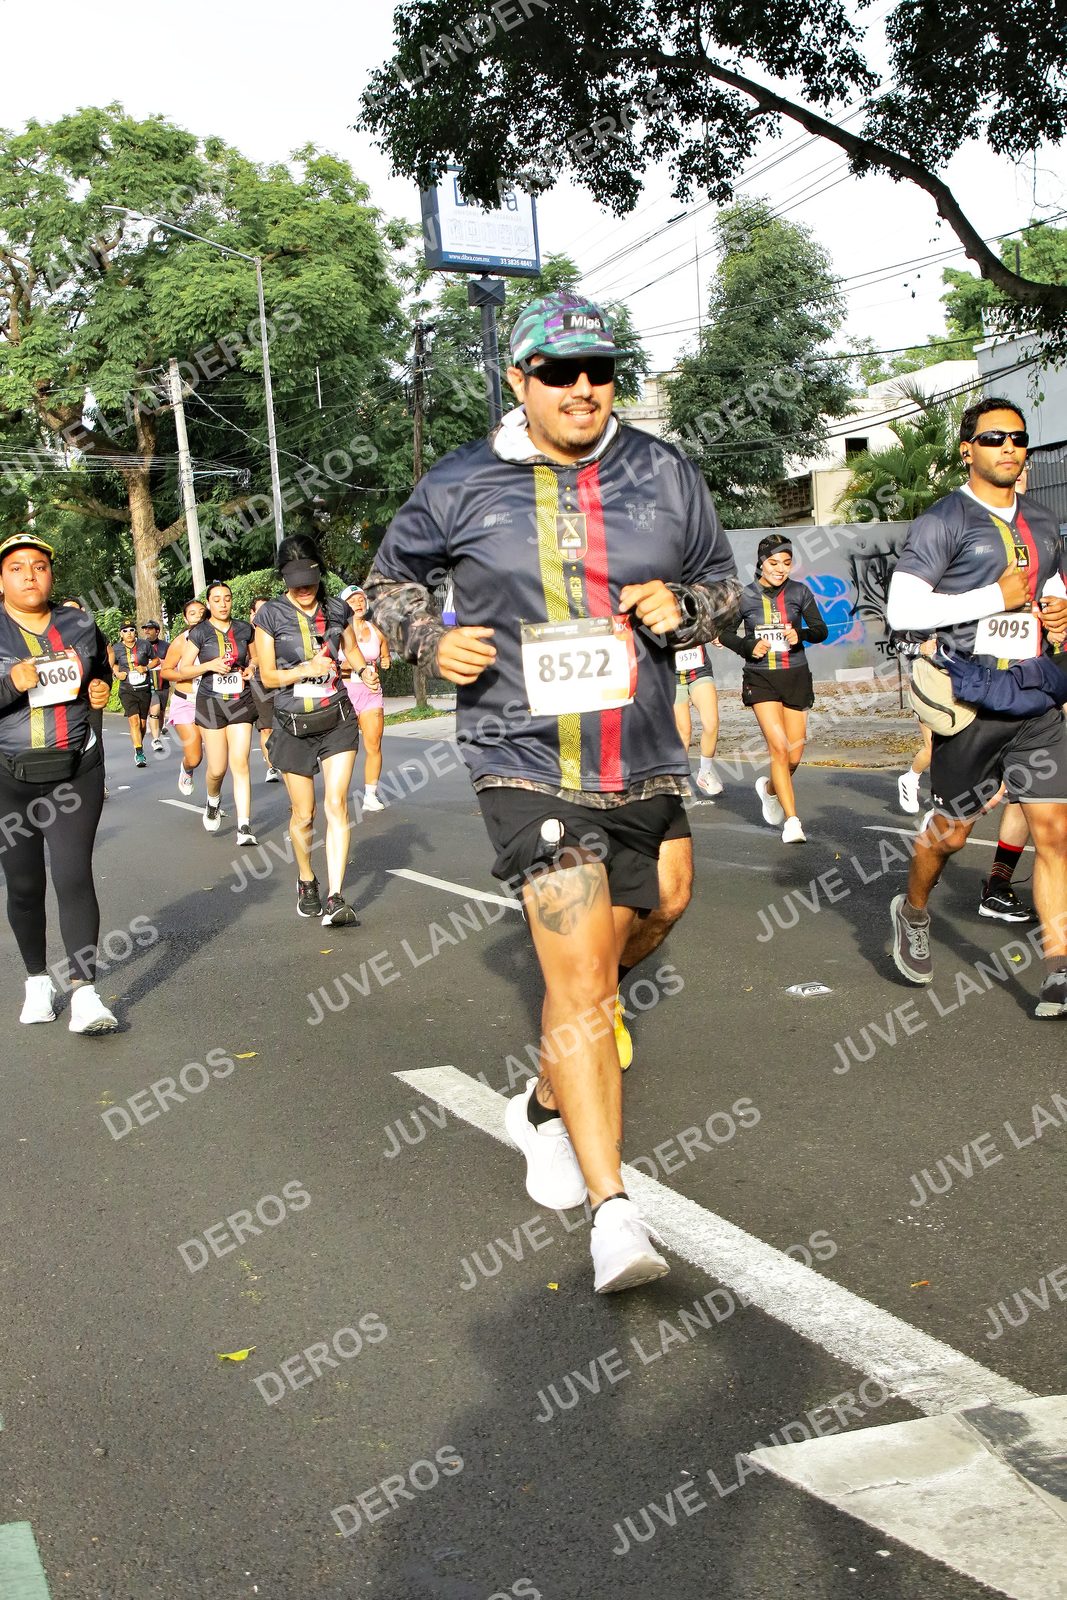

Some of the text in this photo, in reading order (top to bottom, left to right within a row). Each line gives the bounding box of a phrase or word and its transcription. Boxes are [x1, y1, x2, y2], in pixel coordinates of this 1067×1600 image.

[988, 619, 1029, 639] 9095
[538, 649, 612, 682] 8522
[217, 675, 238, 685] 9560
